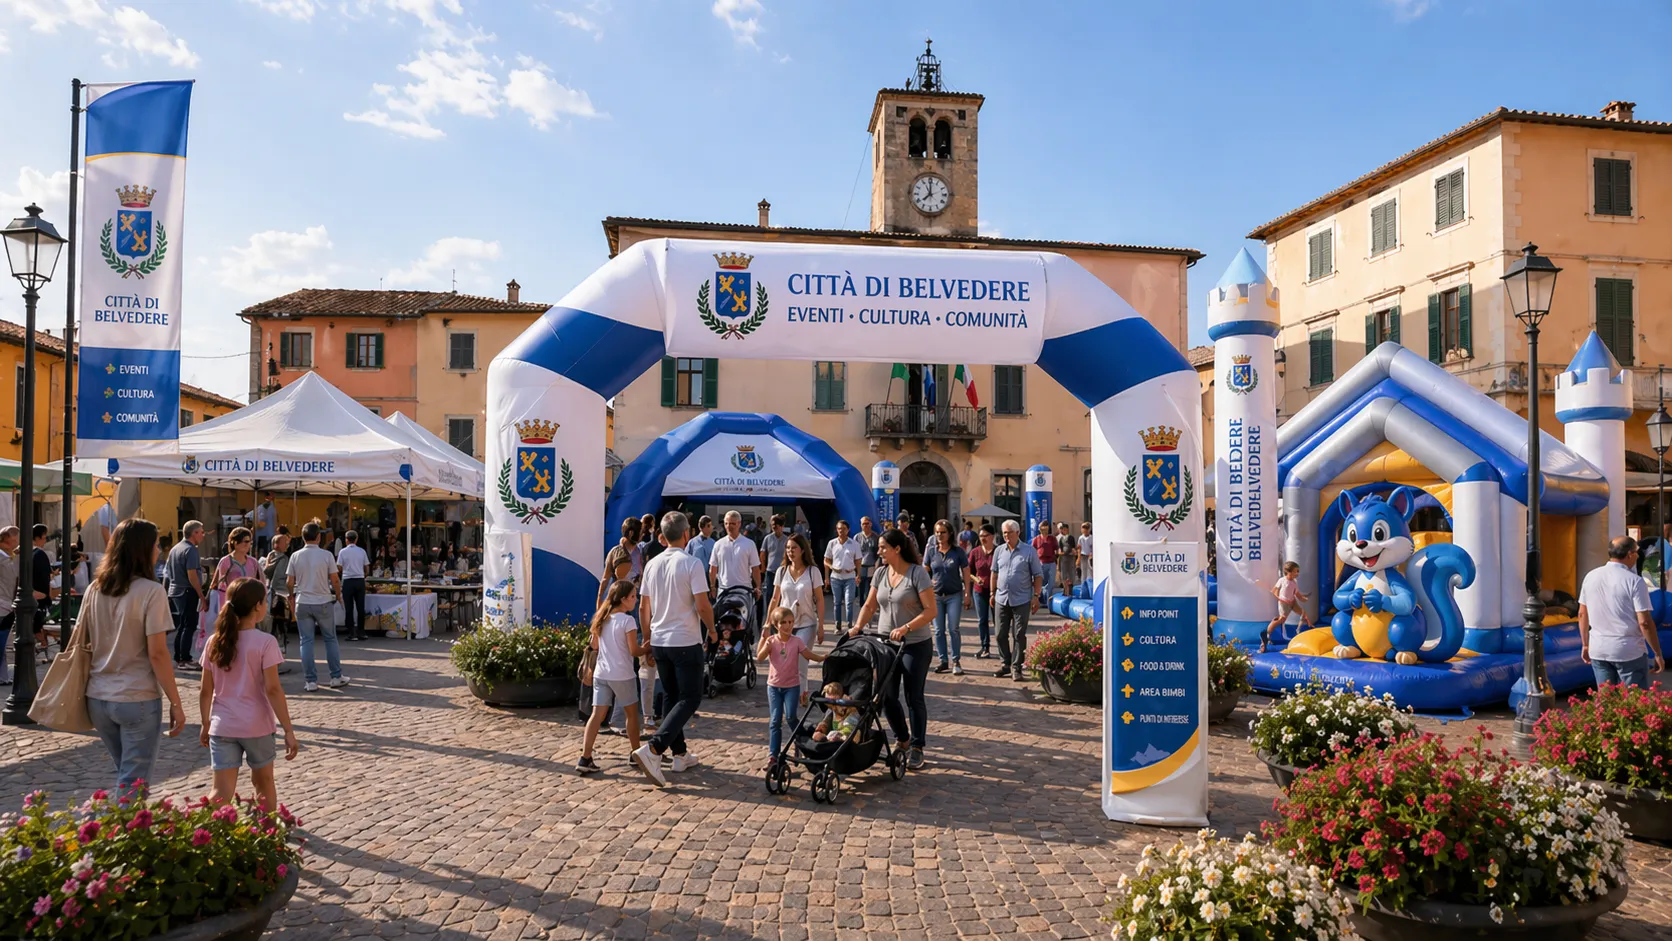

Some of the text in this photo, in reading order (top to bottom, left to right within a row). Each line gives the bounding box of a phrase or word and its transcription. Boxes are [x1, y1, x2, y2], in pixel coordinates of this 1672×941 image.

[787, 270, 1031, 302] CITTÀ DI BELVEDERE
[105, 293, 159, 310] CITTÀ DI
[95, 310, 169, 326] BELVEDERE
[787, 306, 1029, 329] EVENTI CULTURA COMUNITÀ
[120, 364, 149, 376] EVENTI
[118, 388, 155, 399] CULTURA
[116, 411, 159, 424] COMUNITÀ
[204, 458, 335, 473] CITTÀ DI BELVEDERE
[1229, 491, 1243, 508] DI
[1227, 513, 1243, 562] CITTÀ
[1143, 551, 1185, 563] CITTÀ DI
[1143, 564, 1188, 572] BELVEDERE
[1140, 610, 1178, 618] INFO POINT
[1140, 662, 1158, 670] FOOD
[1140, 688, 1160, 696] AREA
